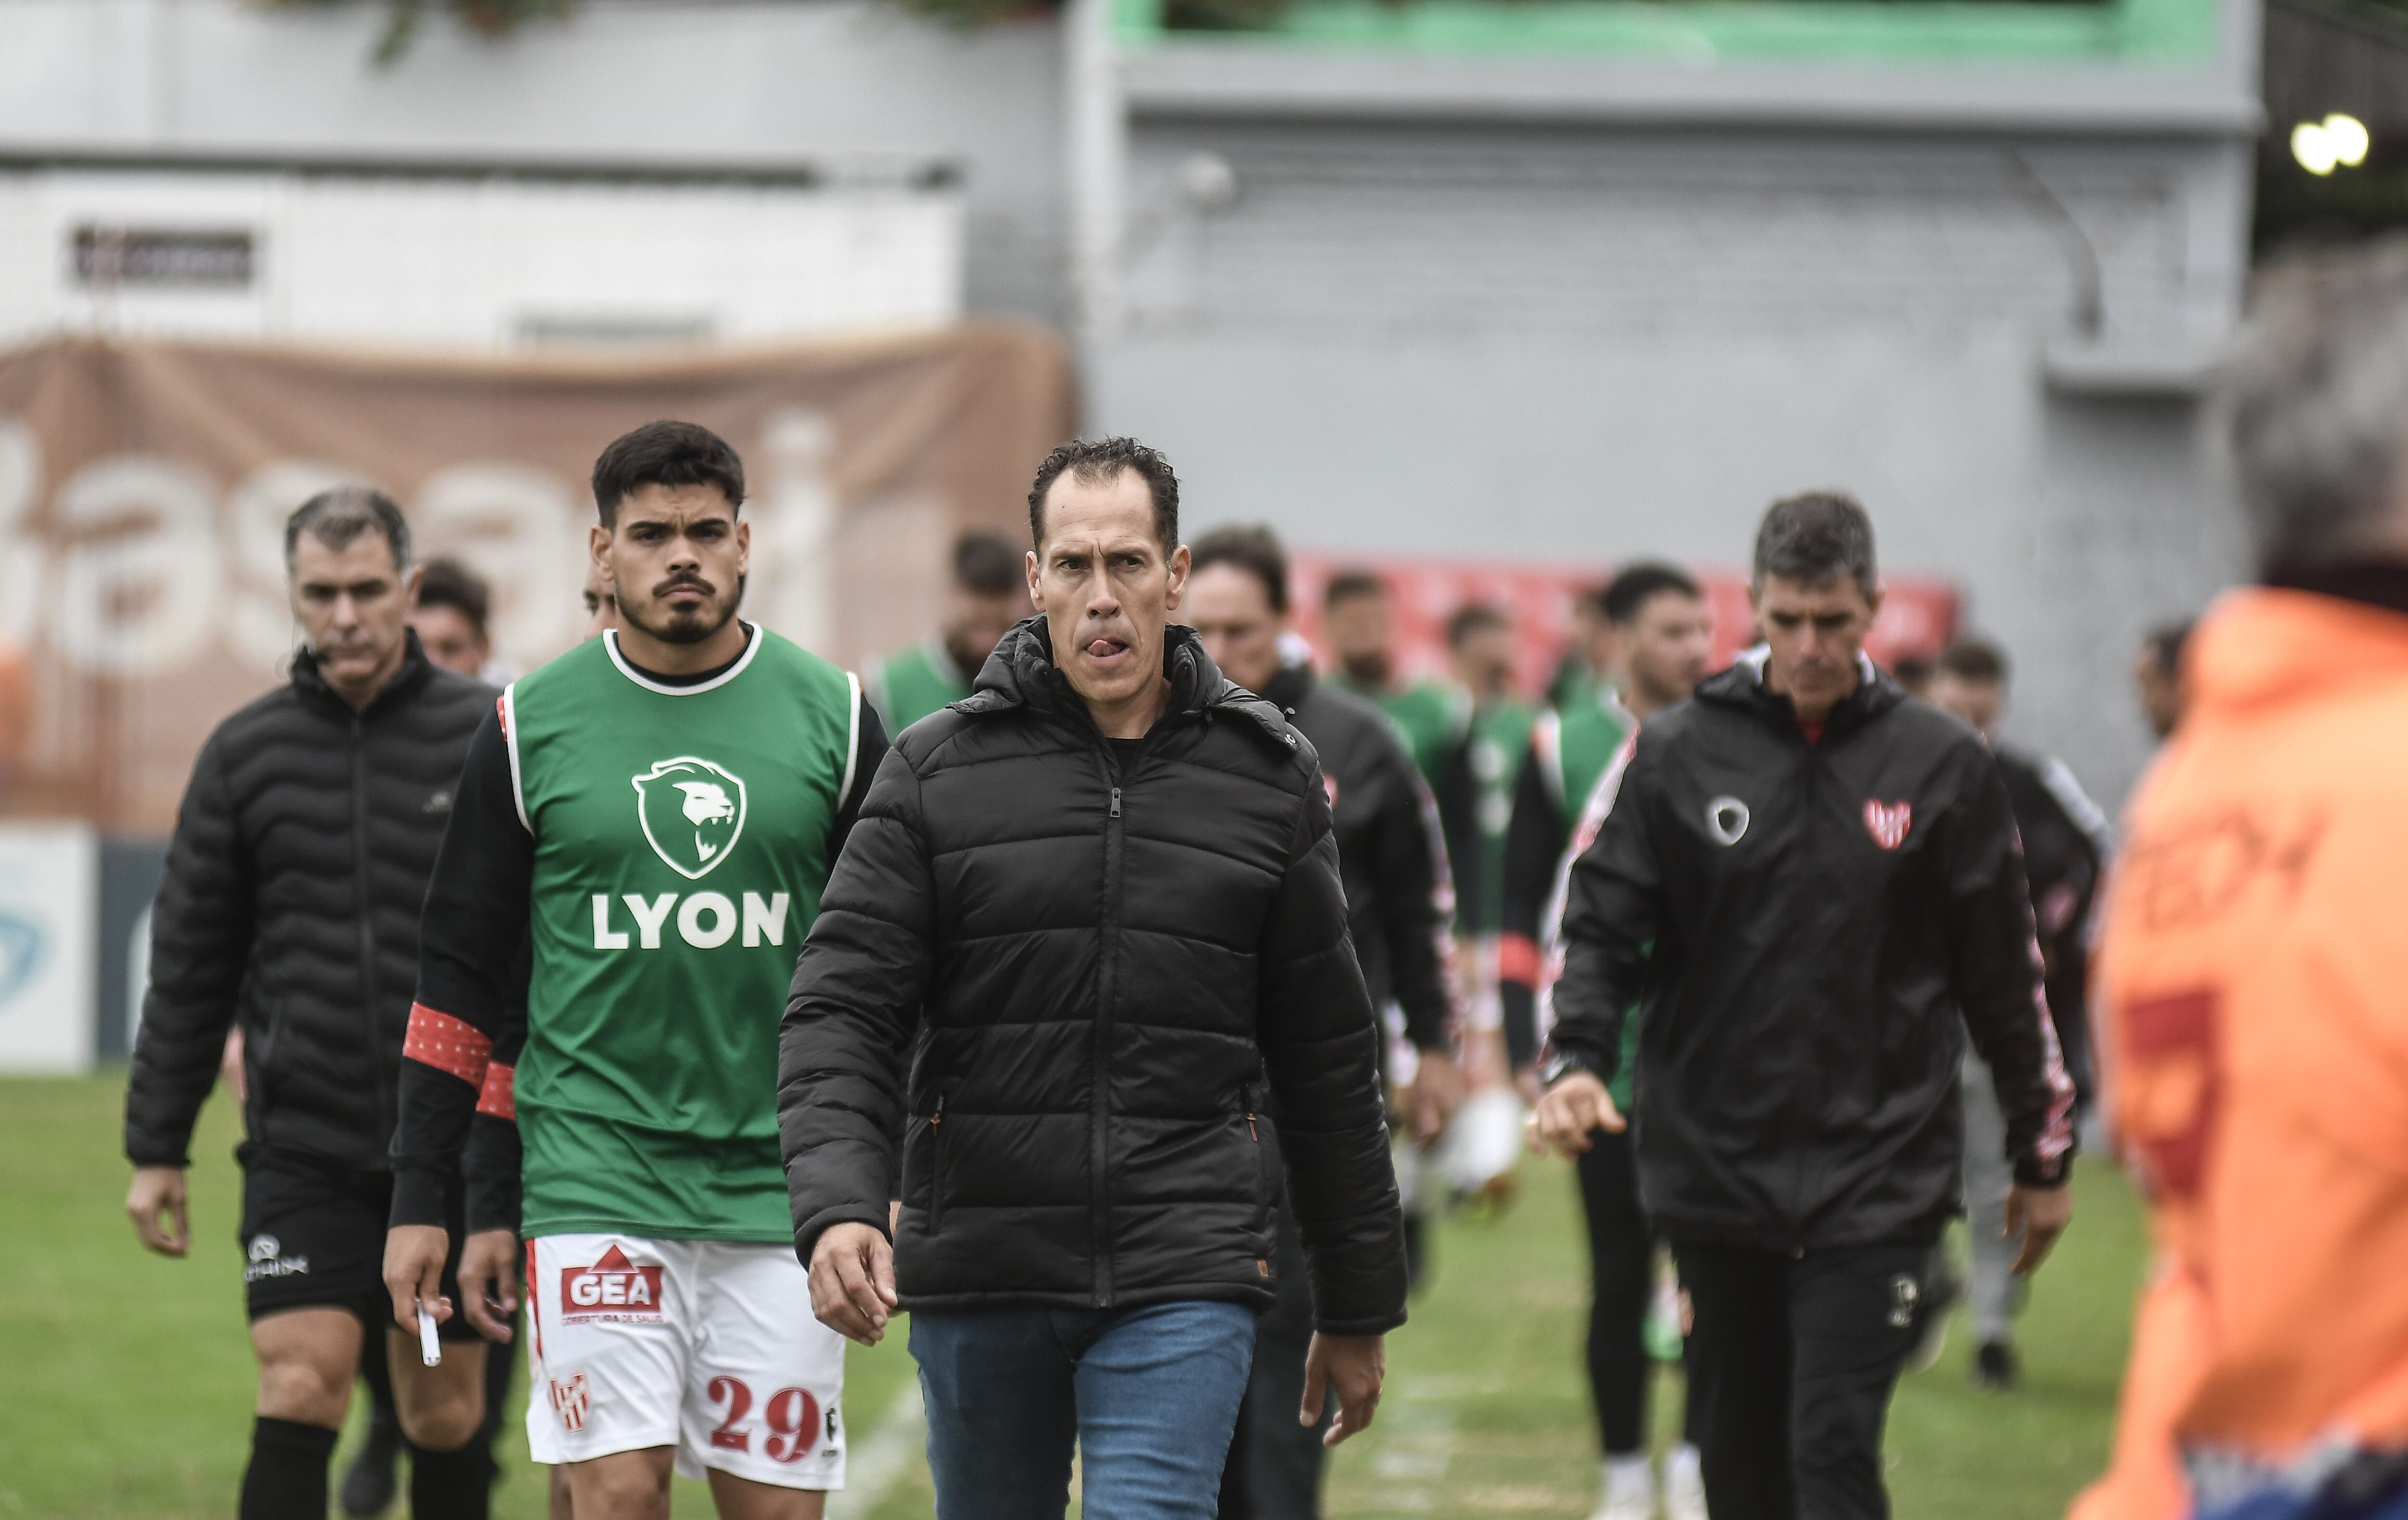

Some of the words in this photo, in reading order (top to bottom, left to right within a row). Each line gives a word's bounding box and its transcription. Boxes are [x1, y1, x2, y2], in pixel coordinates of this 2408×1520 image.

[592, 892, 790, 950] LYON
[570, 1274, 651, 1306] GEA
[708, 1375, 821, 1463] 29
